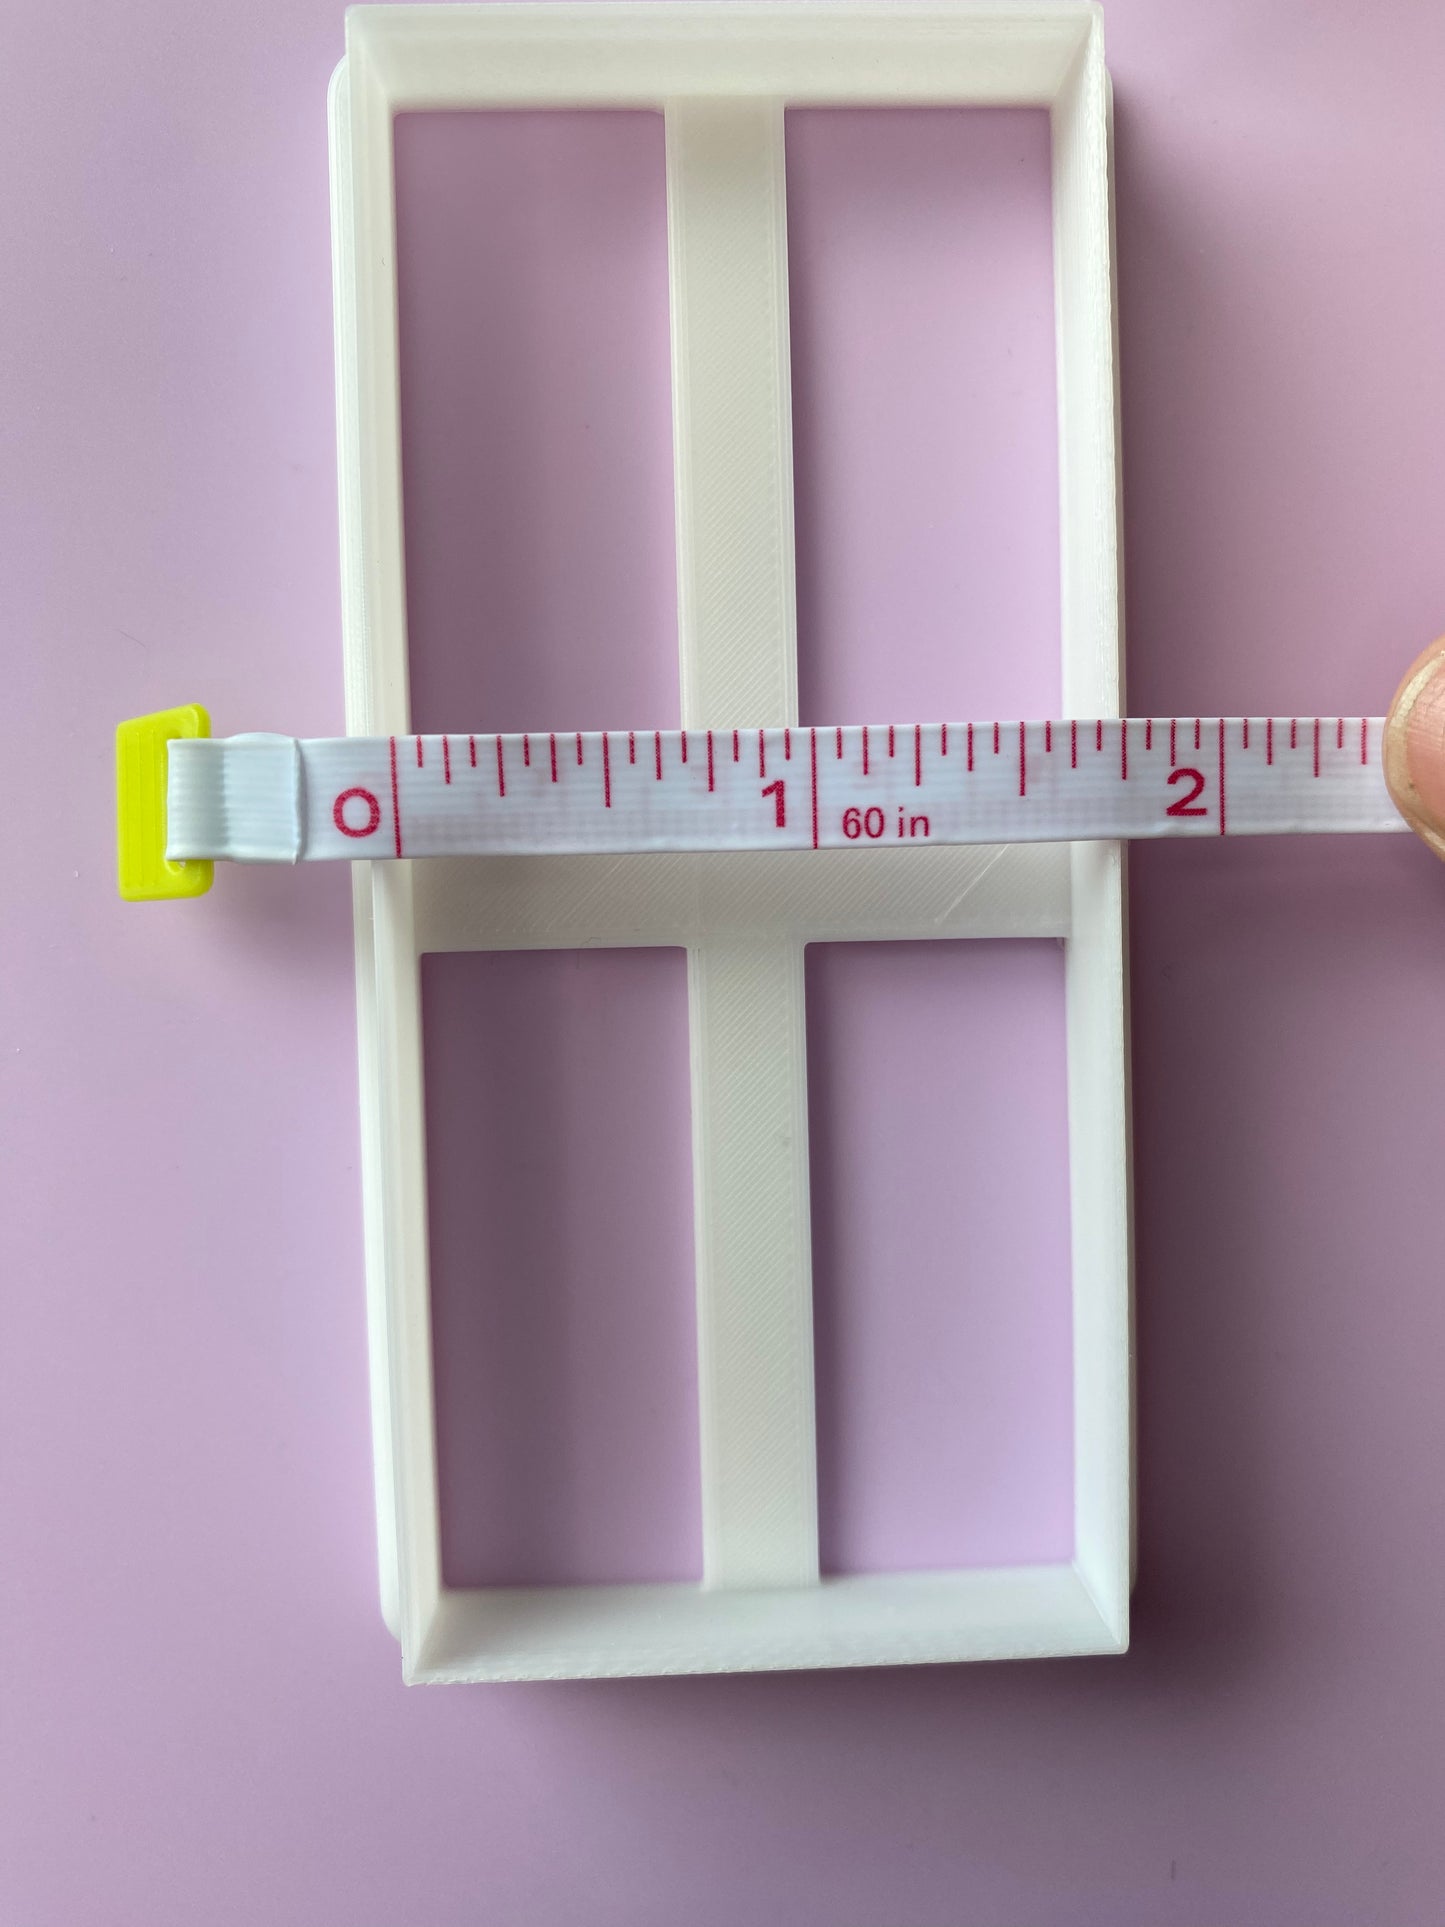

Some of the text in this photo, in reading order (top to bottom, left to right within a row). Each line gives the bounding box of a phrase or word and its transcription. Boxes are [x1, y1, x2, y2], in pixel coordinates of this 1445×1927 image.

[761, 780, 786, 828] 1
[1166, 767, 1208, 817] 2
[841, 807, 930, 840] 60 in
